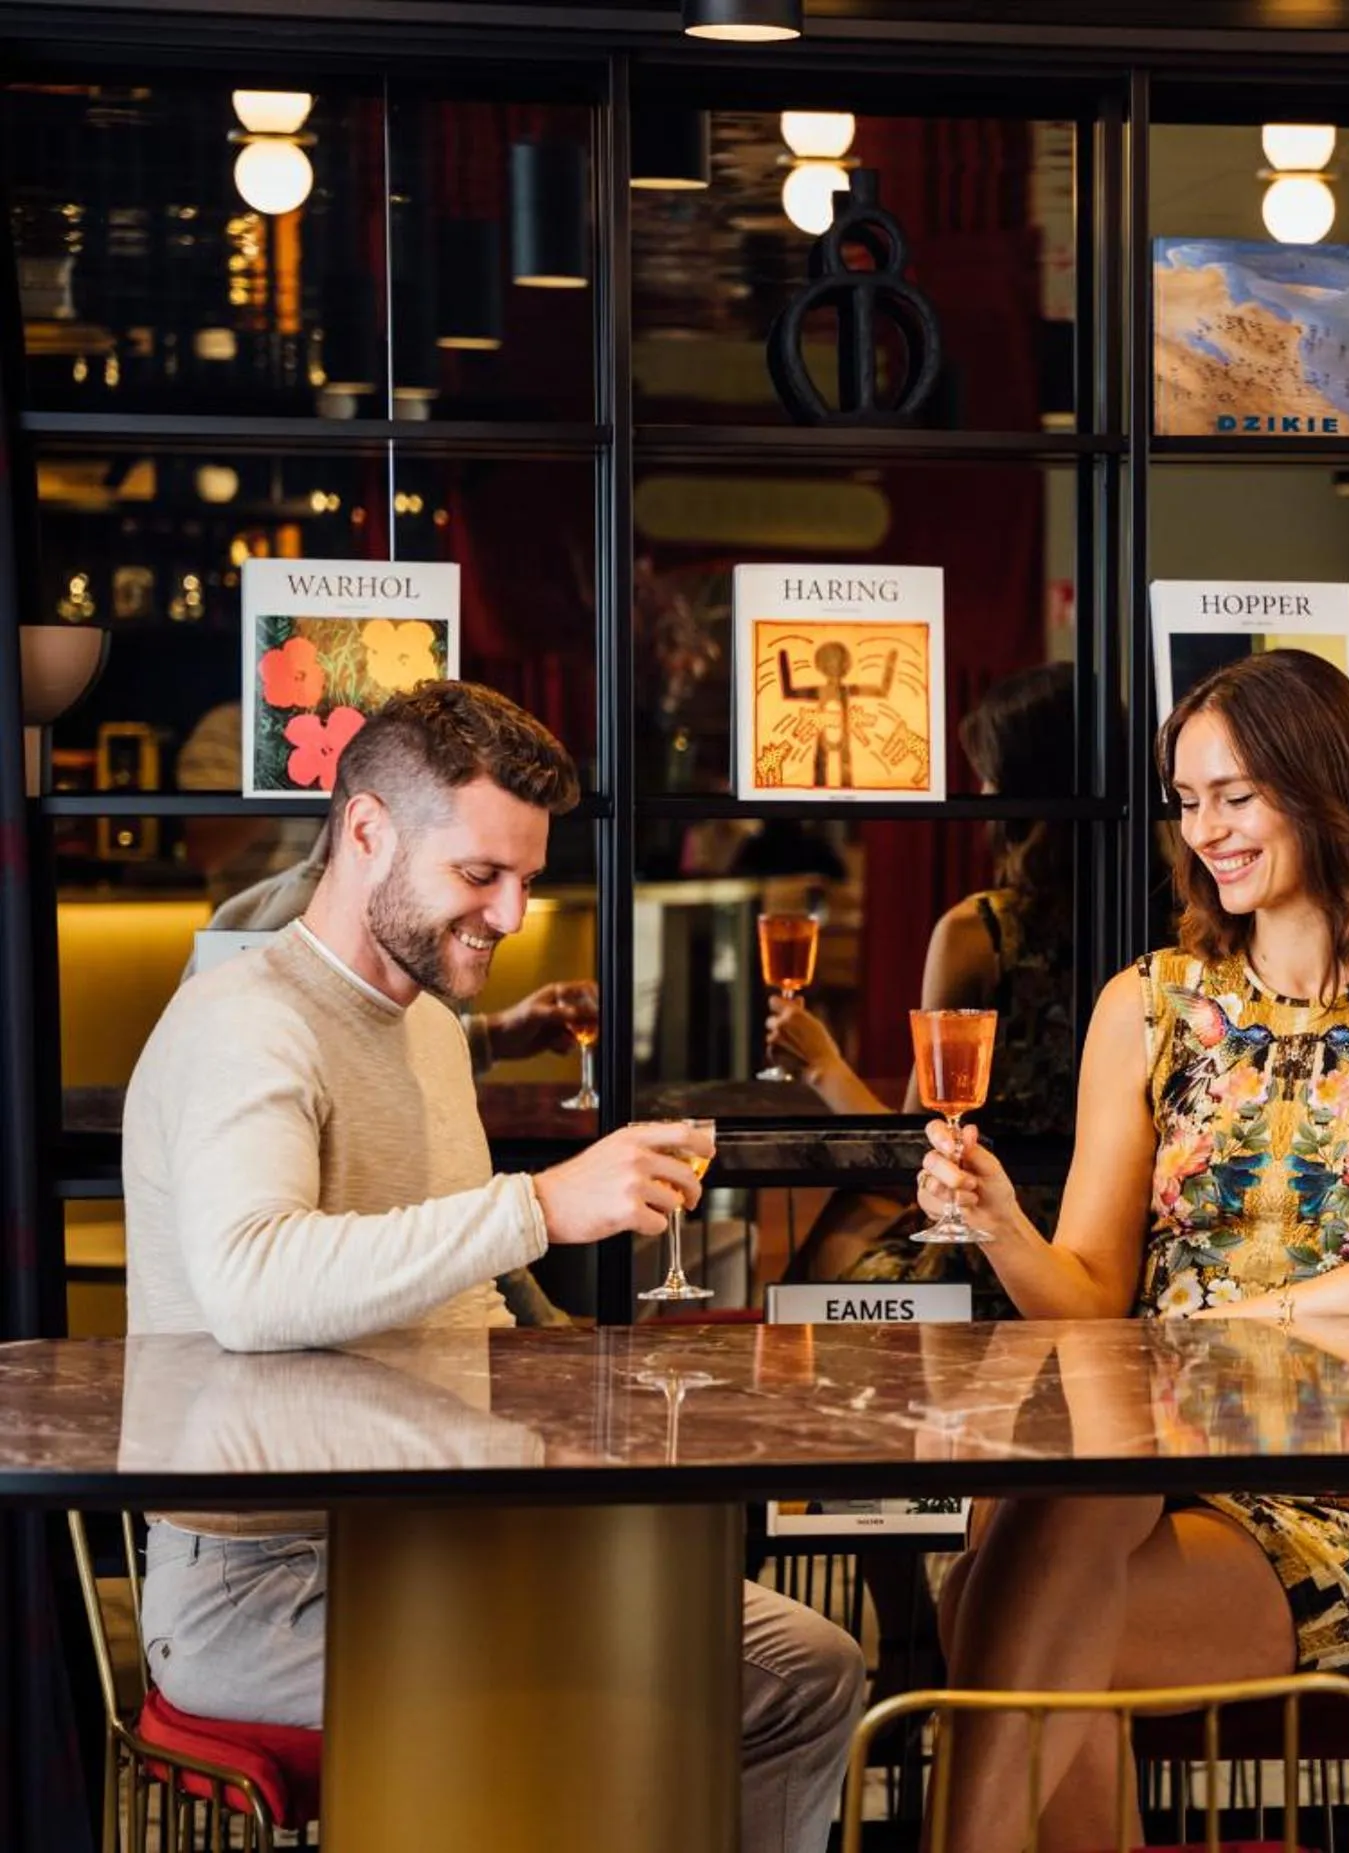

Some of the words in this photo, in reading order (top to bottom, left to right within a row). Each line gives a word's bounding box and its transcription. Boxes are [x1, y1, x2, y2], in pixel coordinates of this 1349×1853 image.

[1216, 415, 1339, 433] DZIKIE
[287, 574, 420, 599] WARHOL
[784, 578, 899, 602] HARING
[1200, 594, 1313, 616] HOPPER
[825, 1299, 915, 1321] EAMES
